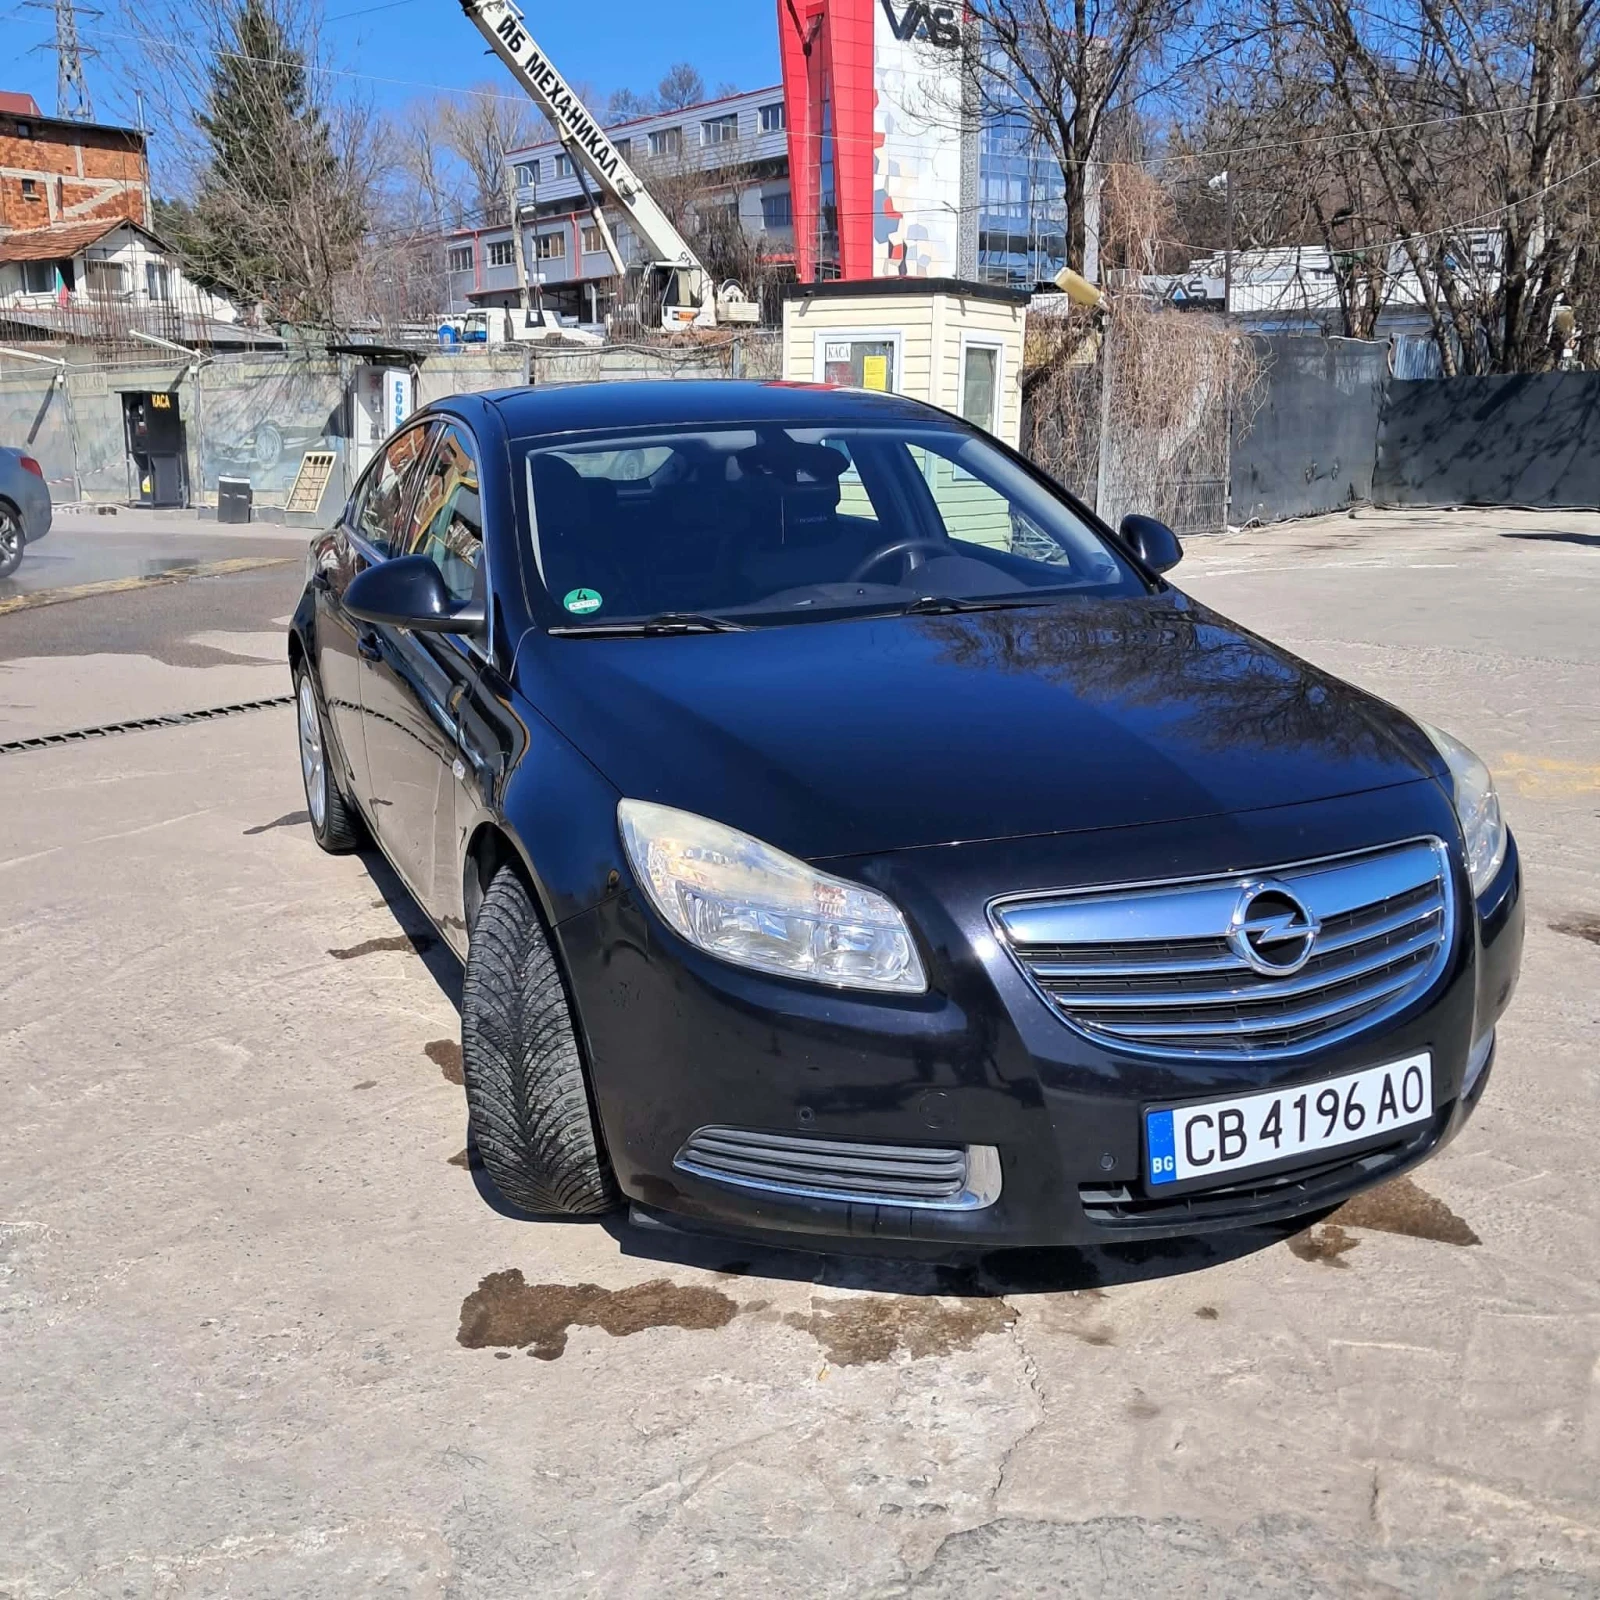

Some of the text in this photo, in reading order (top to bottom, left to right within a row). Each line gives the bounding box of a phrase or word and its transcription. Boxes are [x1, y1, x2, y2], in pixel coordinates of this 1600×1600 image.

[880, 0, 963, 50] VAS
[525, 52, 619, 178] МЕХАНИКАЛ
[151, 393, 171, 409] КАСА
[395, 380, 403, 426] reon
[577, 589, 588, 600] 4
[1185, 1108, 1247, 1167] CB
[1259, 1081, 1366, 1149] 4196
[1152, 1156, 1174, 1174] BG
